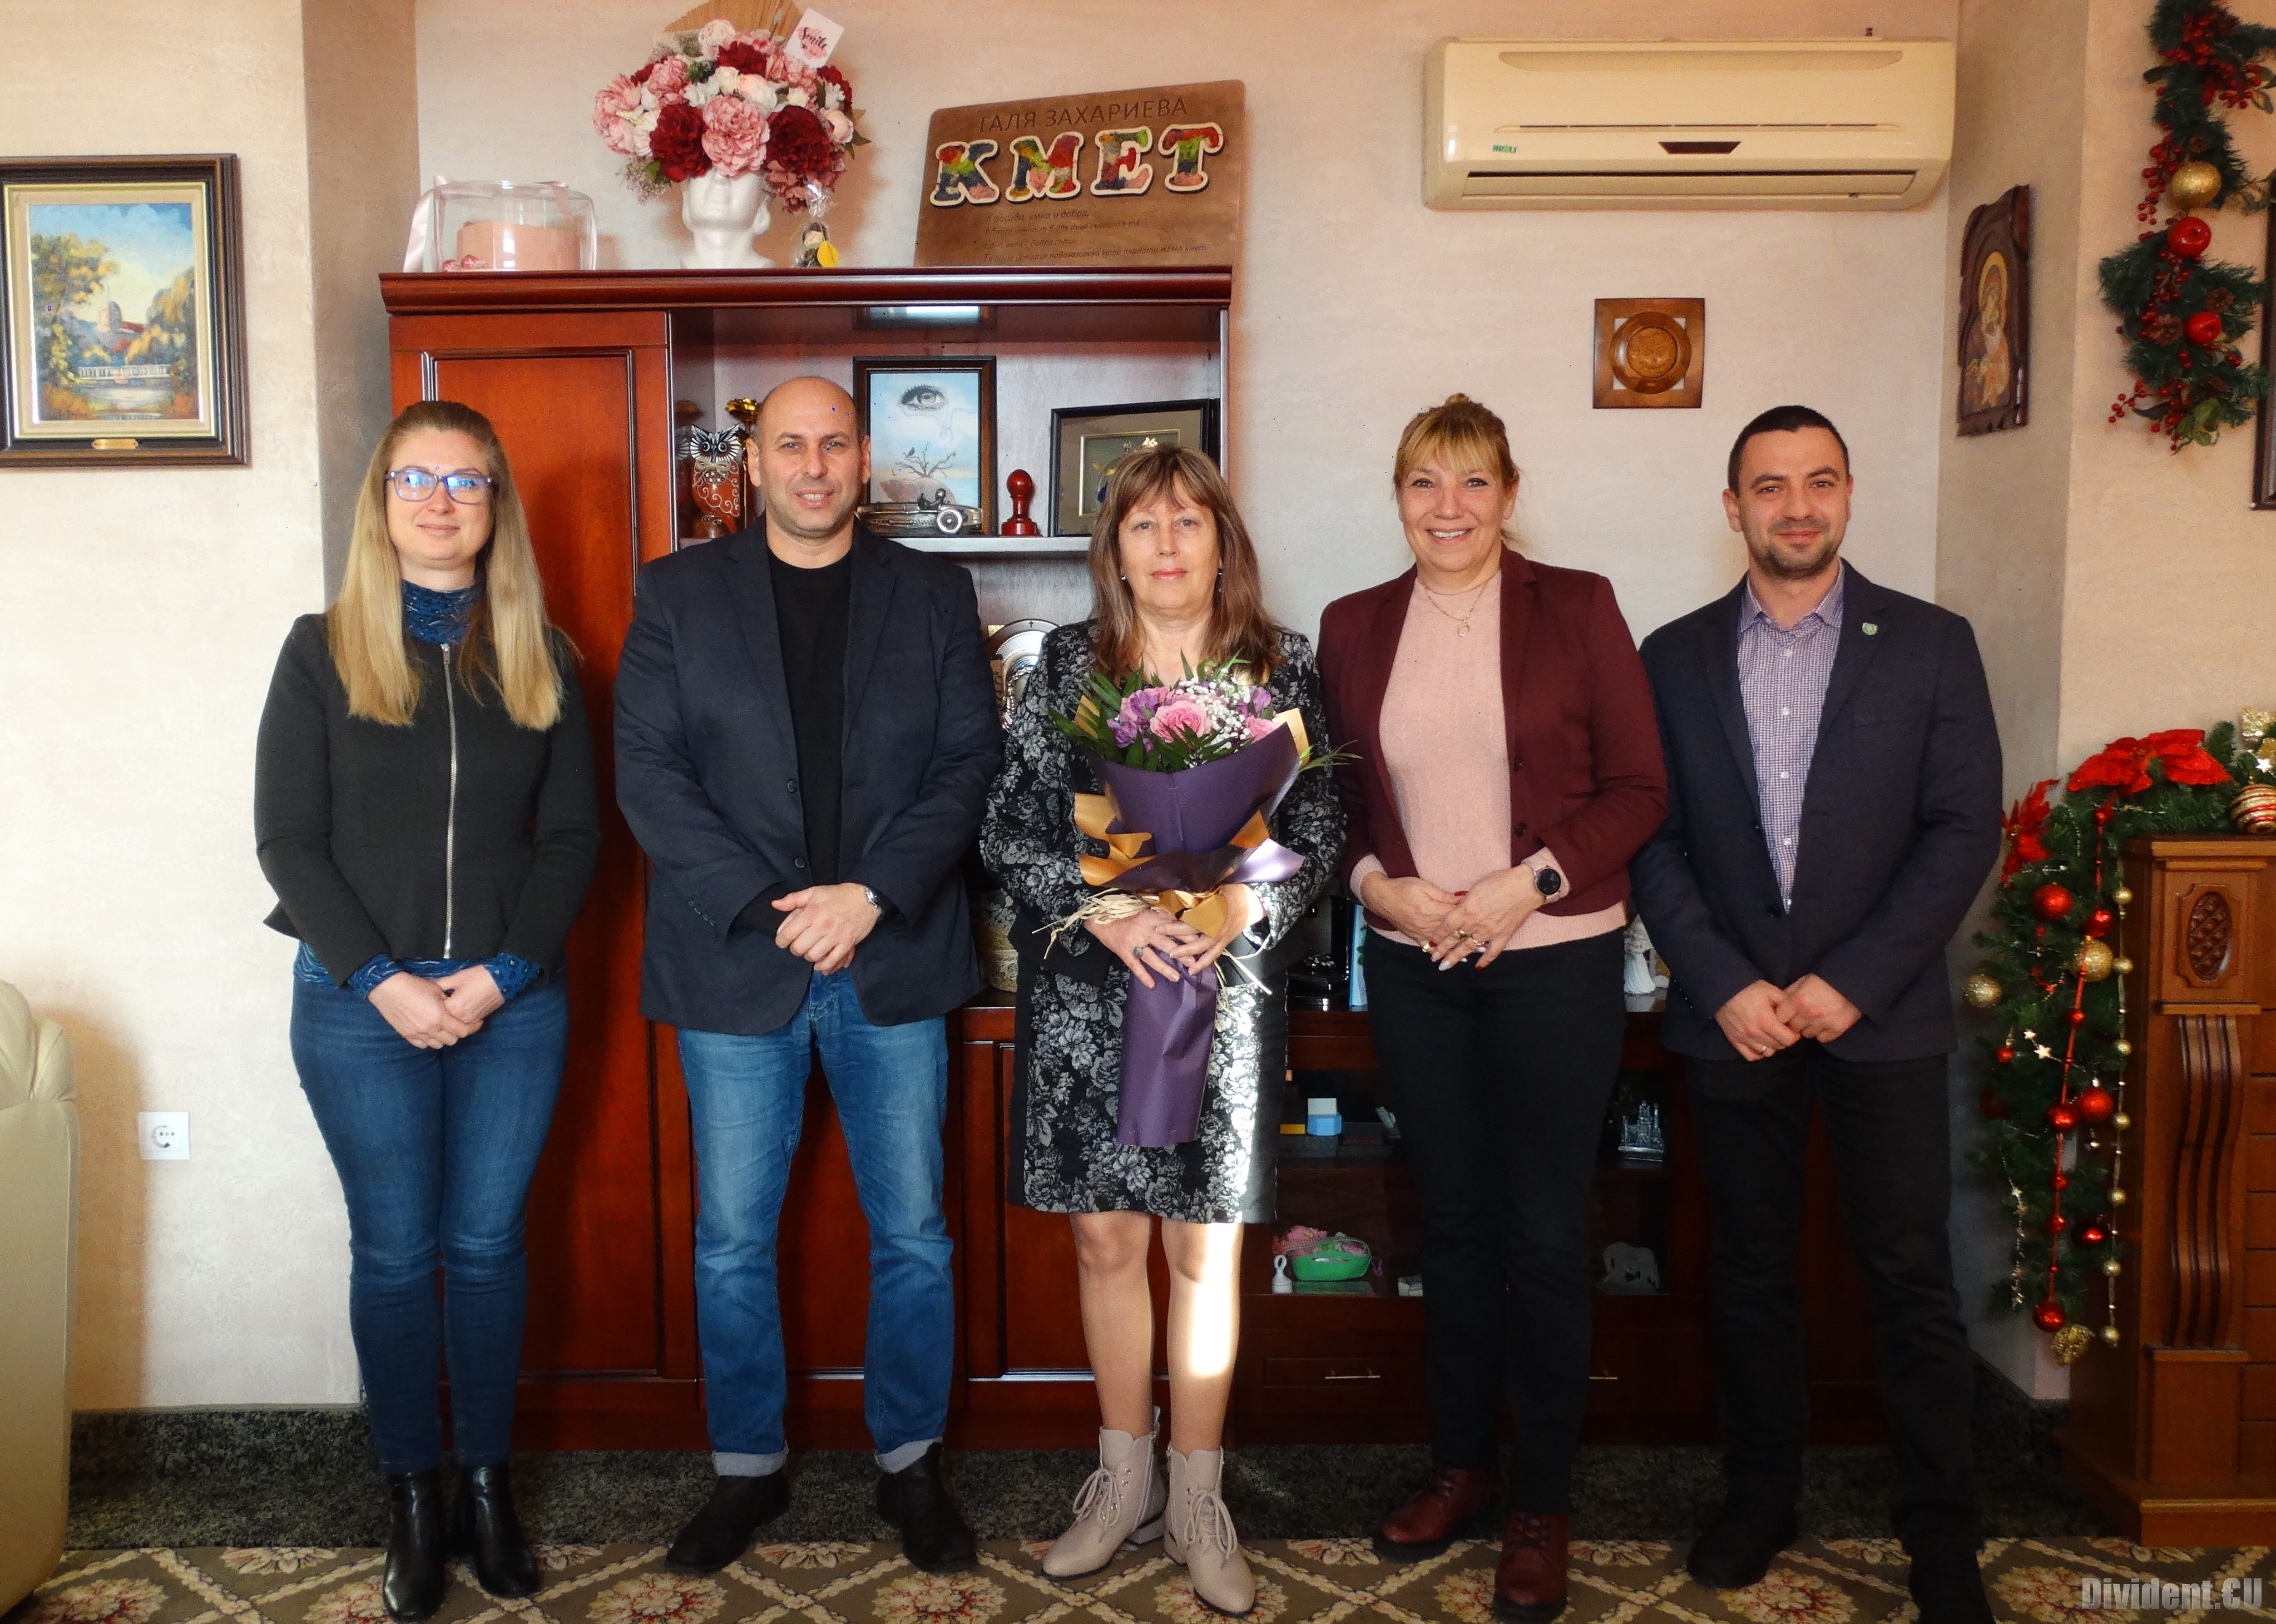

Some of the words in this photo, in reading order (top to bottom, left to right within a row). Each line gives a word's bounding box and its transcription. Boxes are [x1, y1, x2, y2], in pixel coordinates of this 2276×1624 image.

[802, 27, 827, 49] Smile
[979, 112, 1036, 132] ГАЛЯ
[1045, 96, 1187, 127] ЗАХАРИЕВА
[930, 122, 1224, 206] КМЕТ
